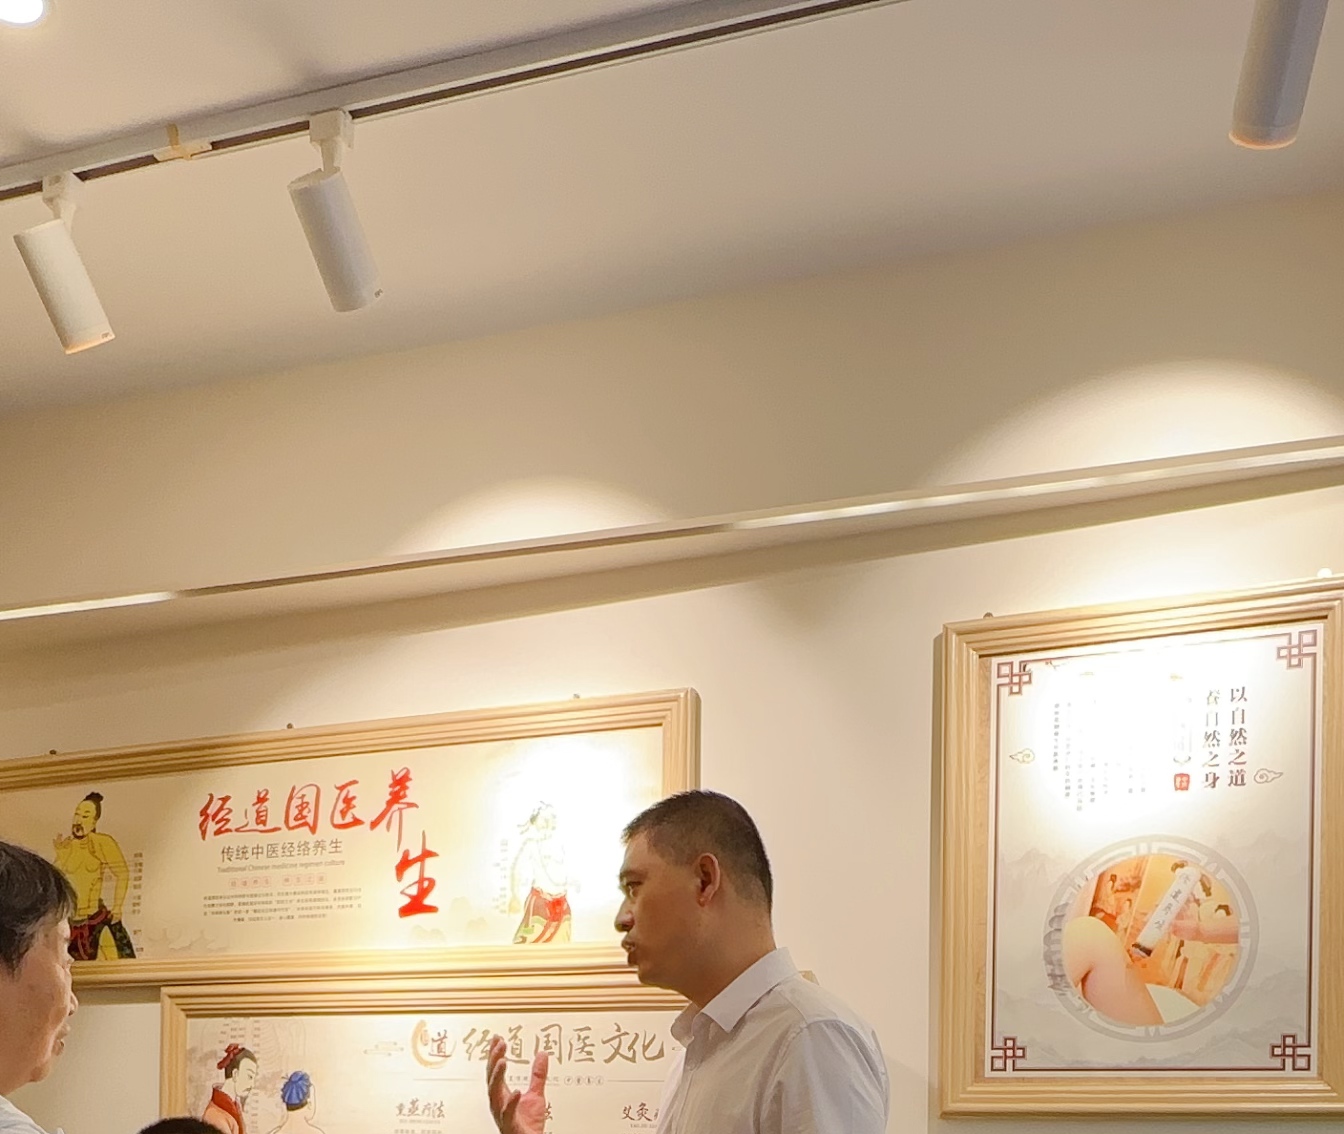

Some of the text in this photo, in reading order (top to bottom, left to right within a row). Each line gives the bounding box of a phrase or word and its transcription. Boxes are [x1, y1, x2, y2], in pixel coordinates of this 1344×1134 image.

[1228, 685, 1248, 788] 以自然之道
[221, 838, 343, 863] 传统中医经络养生
